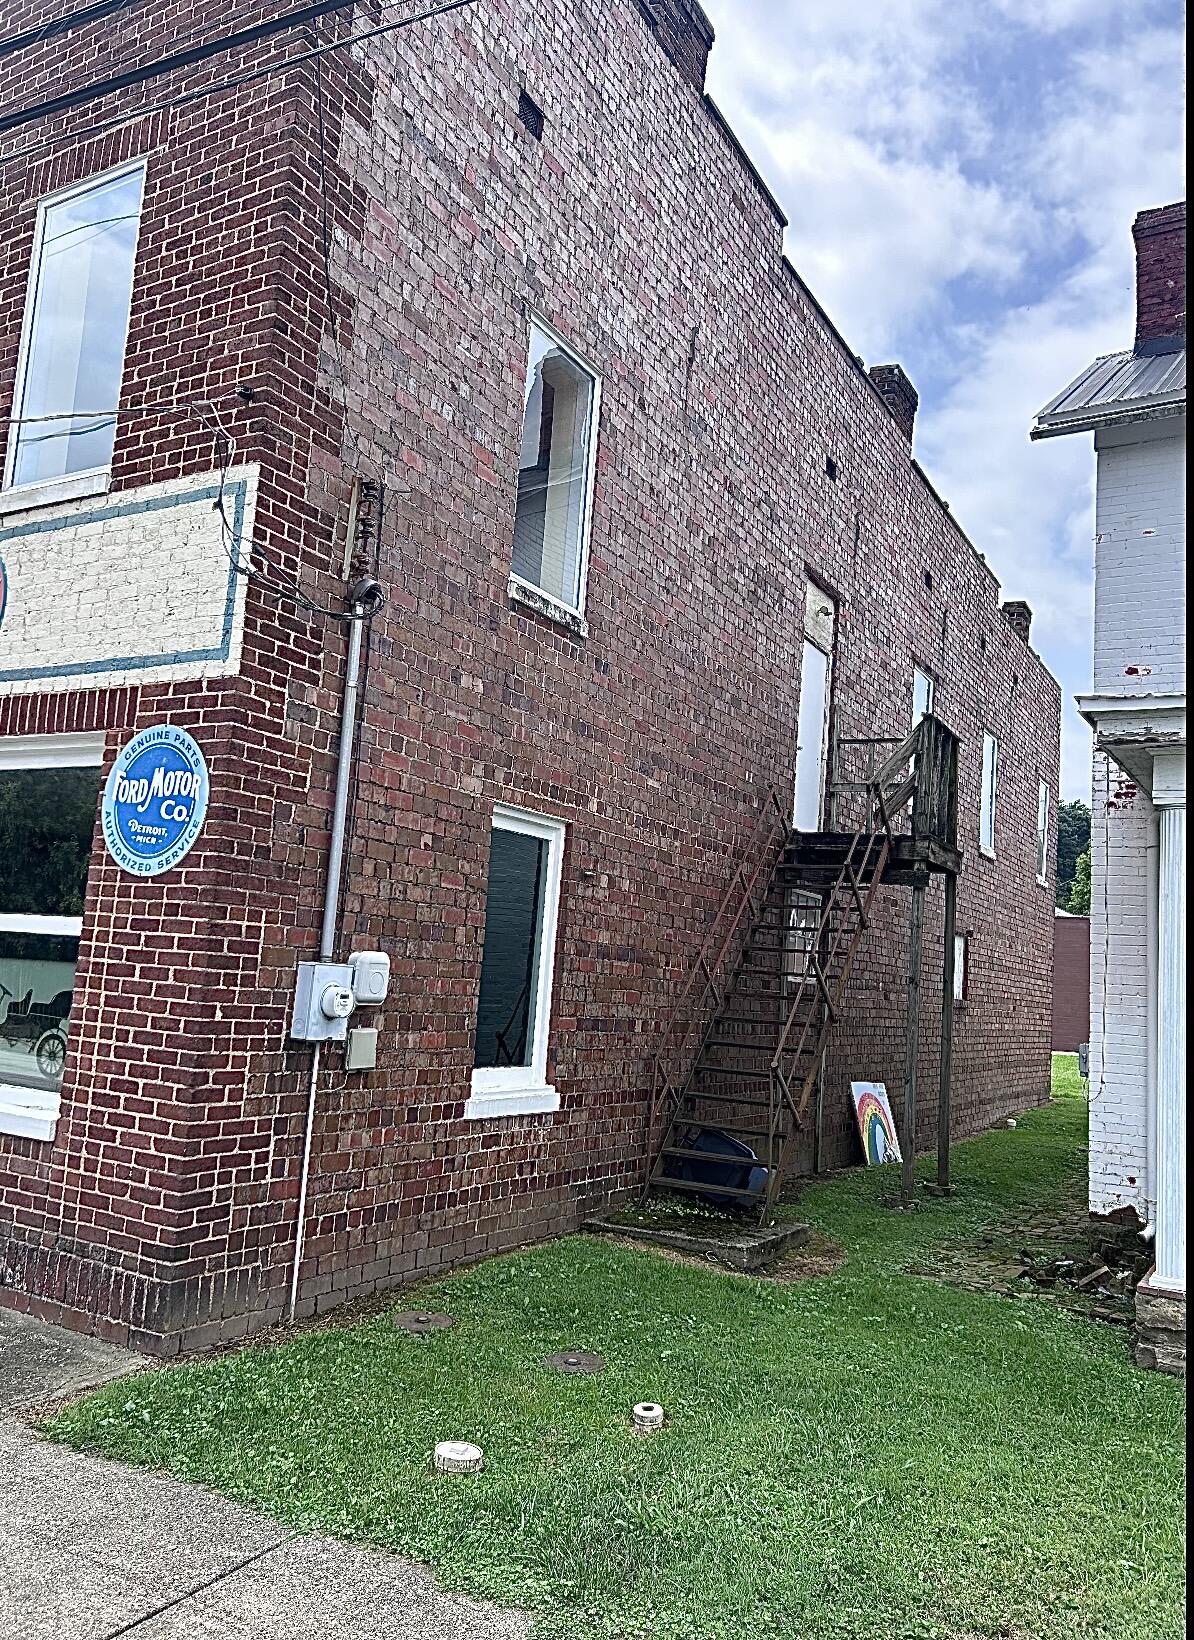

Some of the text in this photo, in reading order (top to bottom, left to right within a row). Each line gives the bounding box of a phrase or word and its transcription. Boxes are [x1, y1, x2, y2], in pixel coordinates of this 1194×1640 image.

[124, 730, 201, 767] GENUINE PARTS
[112, 767, 202, 812] FORD MOTOR
[105, 810, 200, 872] AUTHORIZED SERVICE
[128, 819, 168, 837] DETROIT,
